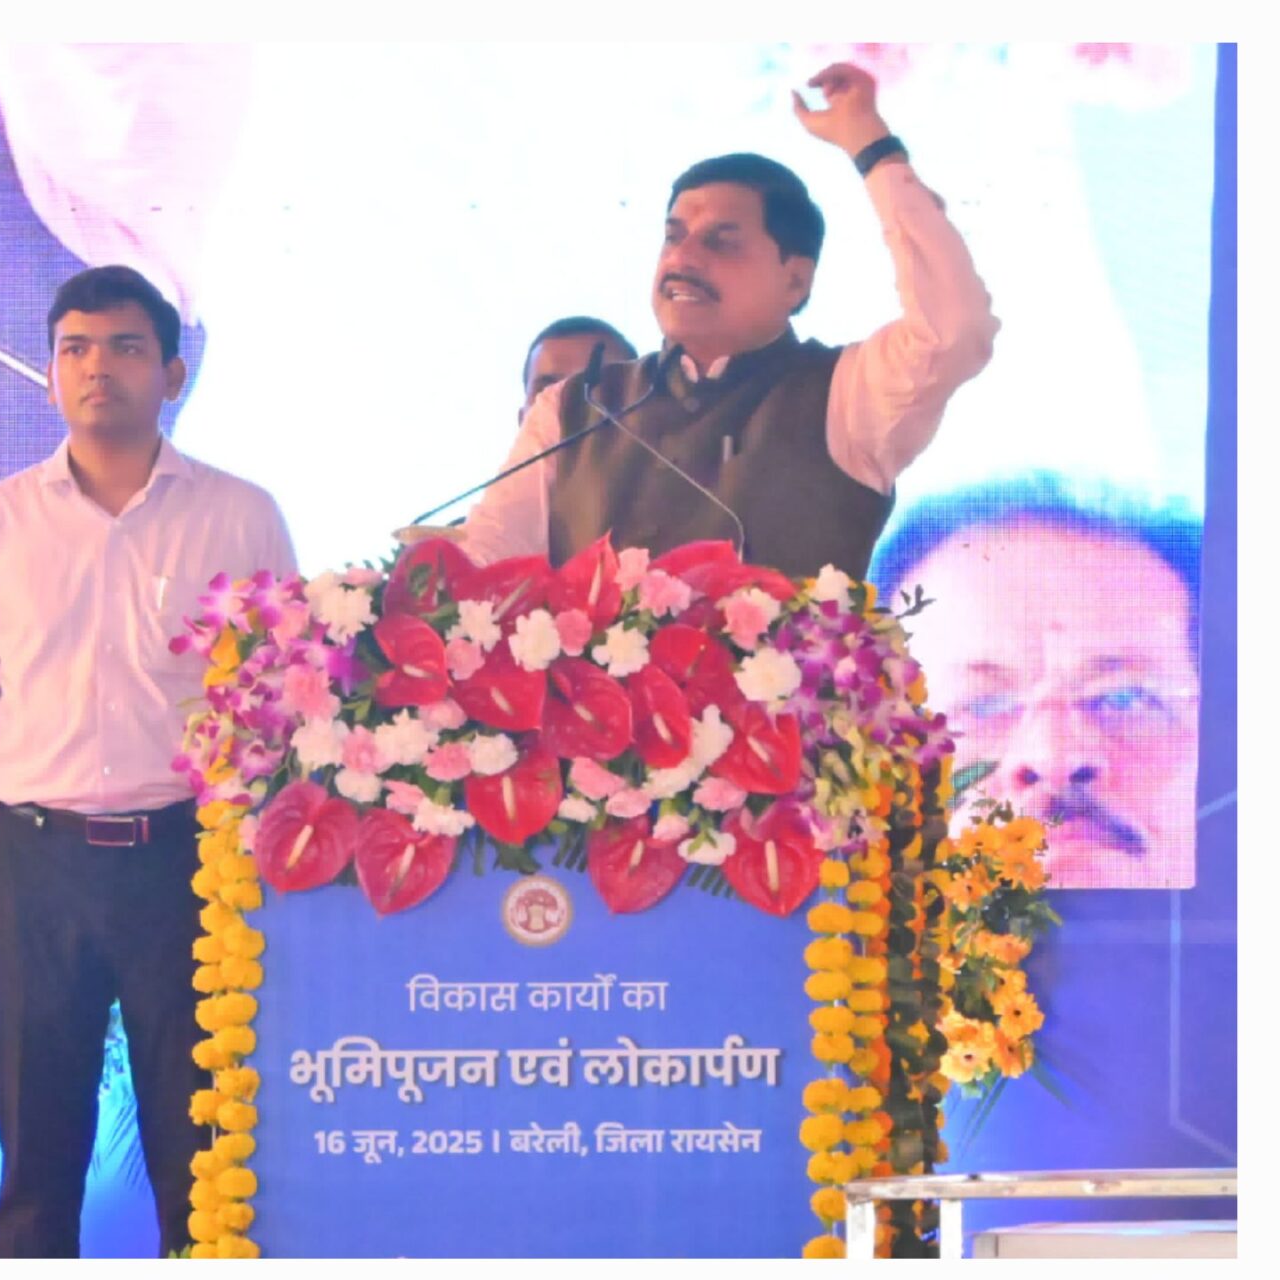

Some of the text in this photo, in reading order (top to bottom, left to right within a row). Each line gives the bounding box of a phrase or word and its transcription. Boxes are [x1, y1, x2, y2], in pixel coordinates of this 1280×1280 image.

[405, 973, 519, 1012] विकास
[620, 981, 669, 1011] का
[289, 1034, 780, 1103] भूमिपूजन एवं लोकार्पण
[314, 1130, 346, 1154] 16
[351, 1130, 404, 1164] जून,
[411, 1130, 483, 1154] 2025
[509, 1121, 588, 1158] बरेली,
[594, 1121, 665, 1153] जिला
[671, 1121, 762, 1153] रायसेन
